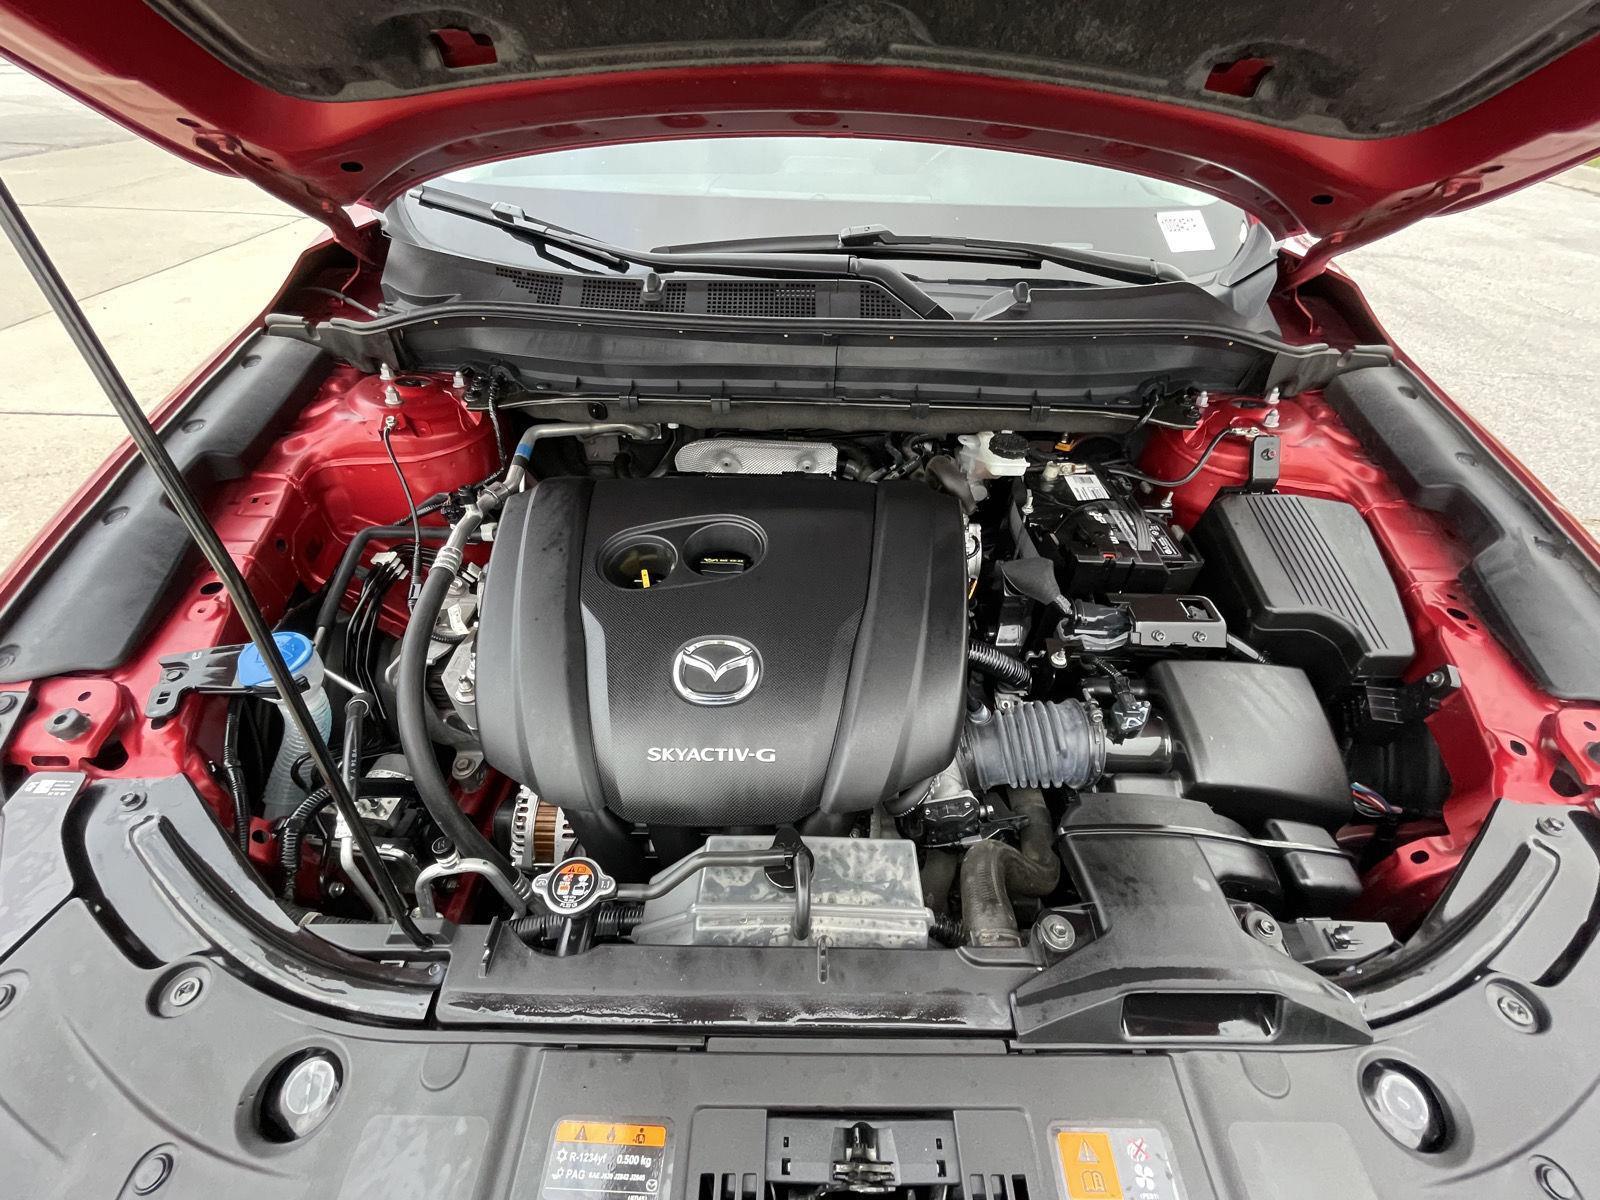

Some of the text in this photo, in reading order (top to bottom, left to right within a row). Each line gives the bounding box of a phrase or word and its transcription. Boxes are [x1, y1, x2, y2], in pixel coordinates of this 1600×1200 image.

[646, 747, 776, 762] SKYACTIV-G
[569, 1151, 652, 1168] R-1234yf 0.500 kg
[565, 1169, 585, 1180] PAG
